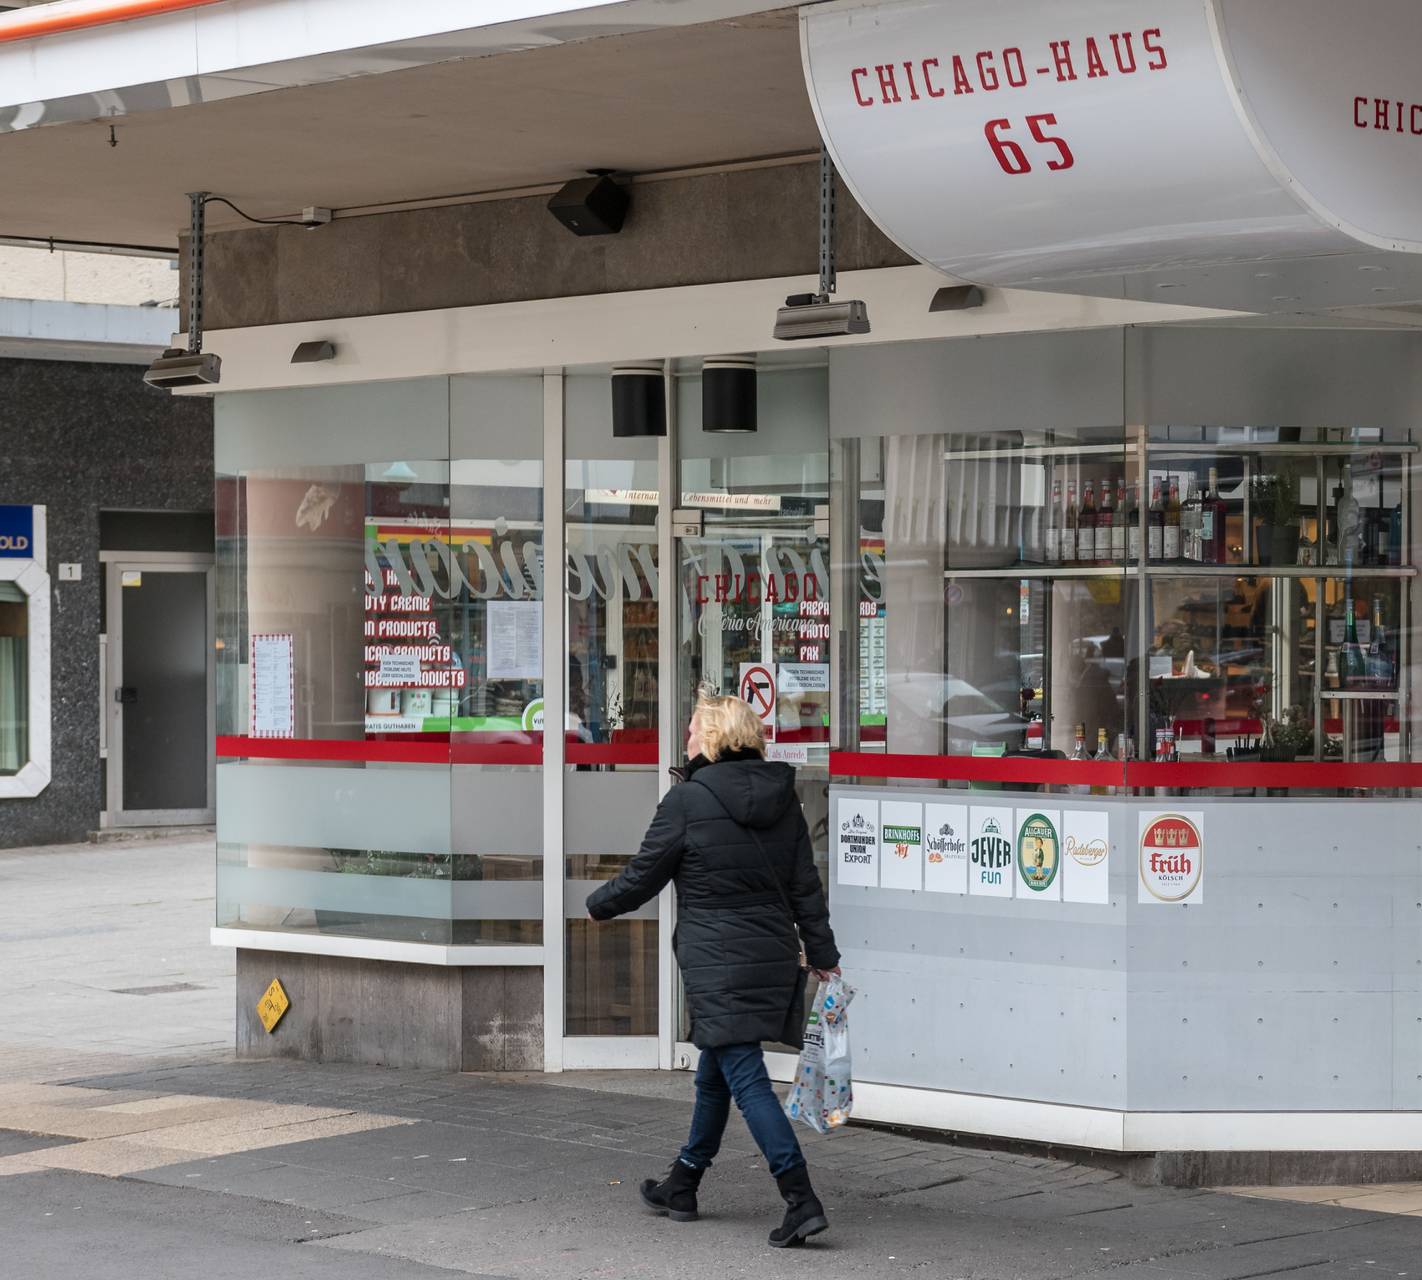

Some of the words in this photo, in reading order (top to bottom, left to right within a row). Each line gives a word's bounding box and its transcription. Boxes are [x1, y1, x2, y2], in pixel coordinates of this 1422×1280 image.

[851, 27, 1169, 108] CHICAGO-HAUS
[983, 112, 1075, 175] 65
[683, 492, 733, 503] Lebensmittel
[734, 495, 749, 504] und
[67, 566, 73, 578] 1
[695, 573, 818, 604] CHICAGO
[391, 595, 430, 612] CREME
[379, 621, 436, 637] PRODUCTS
[840, 834, 876, 845] DORTMUNDER
[972, 836, 1011, 868] JEVER
[981, 870, 1001, 884] FUN
